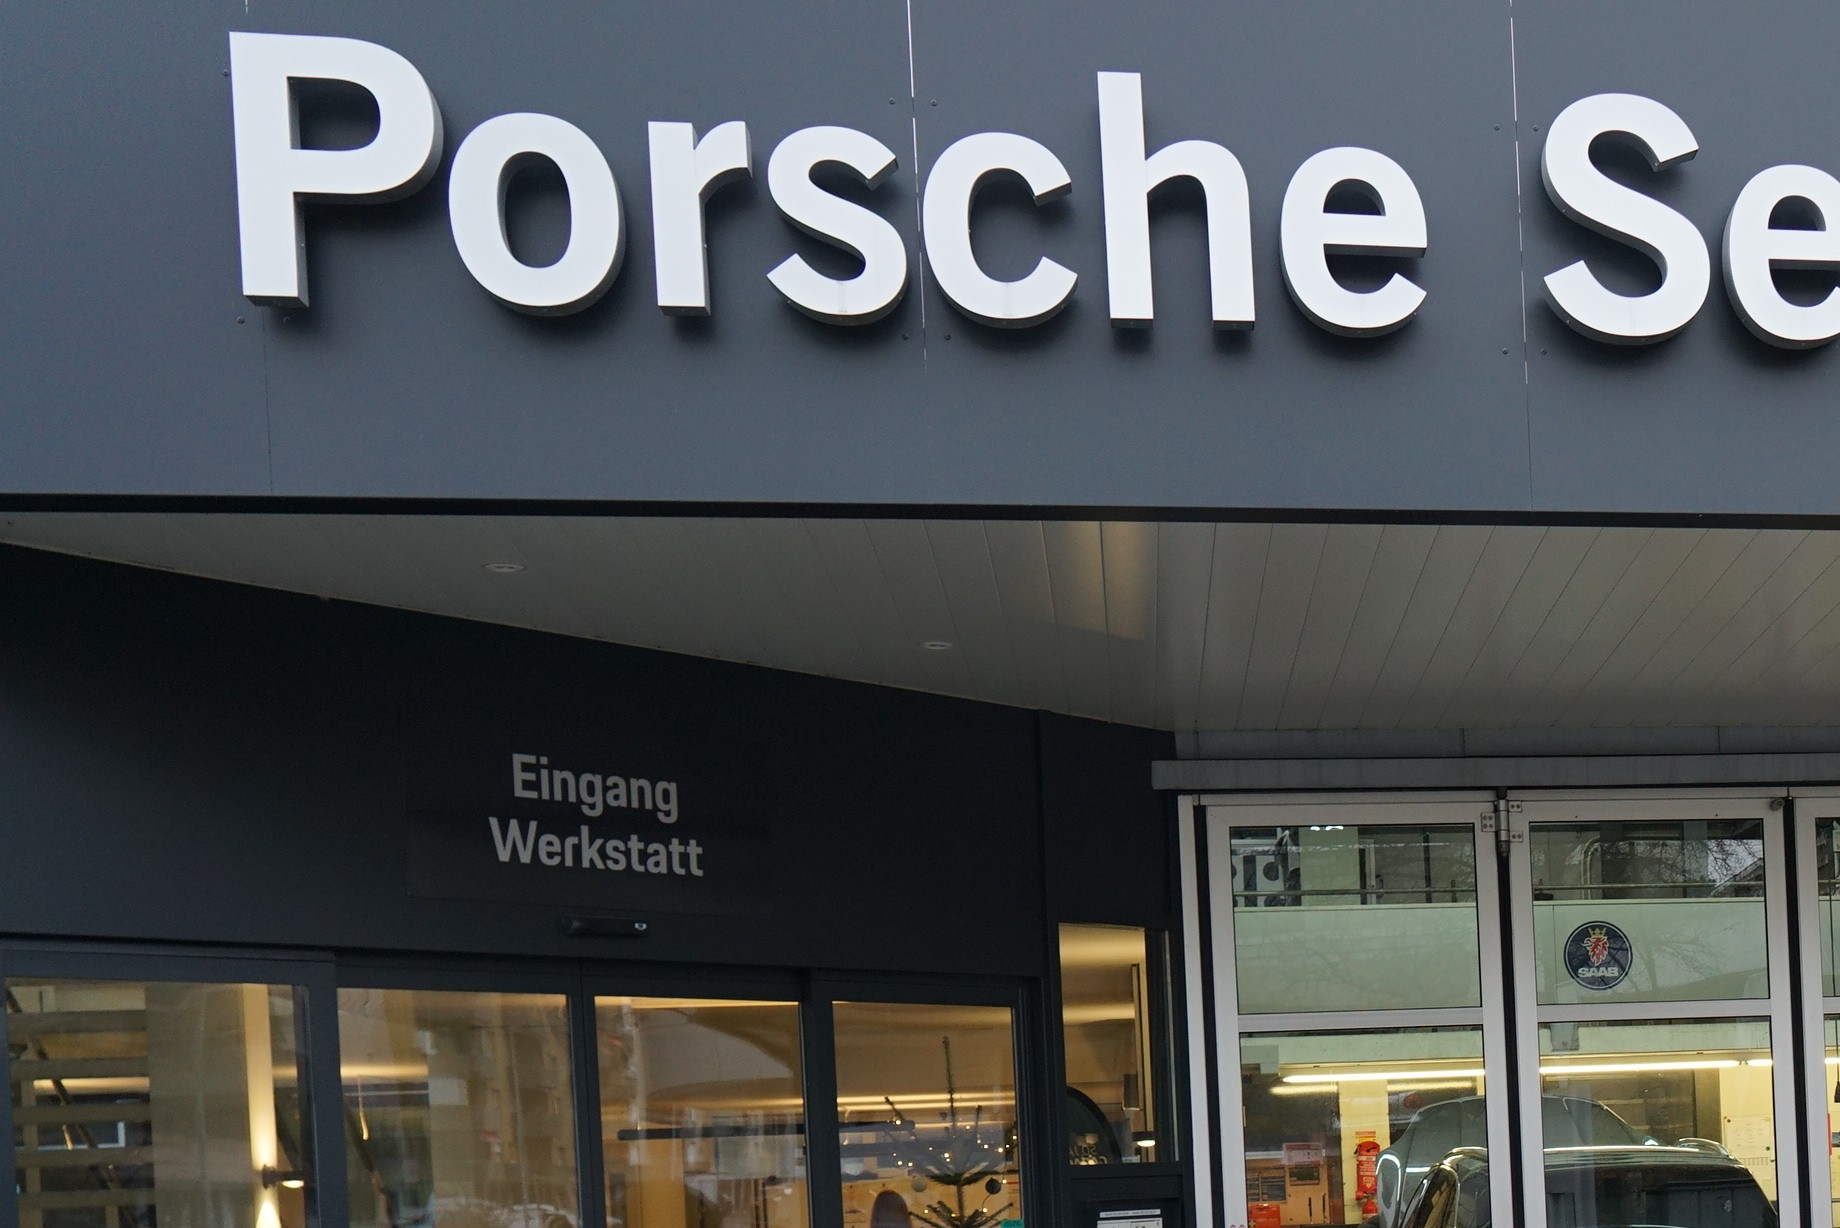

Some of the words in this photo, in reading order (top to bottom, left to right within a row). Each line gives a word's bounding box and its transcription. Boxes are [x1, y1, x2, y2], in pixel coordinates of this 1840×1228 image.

[229, 30, 1428, 341] Porsche
[512, 753, 679, 824] Eingang
[488, 816, 704, 876] Werkstatt
[1577, 966, 1619, 978] SAAB
